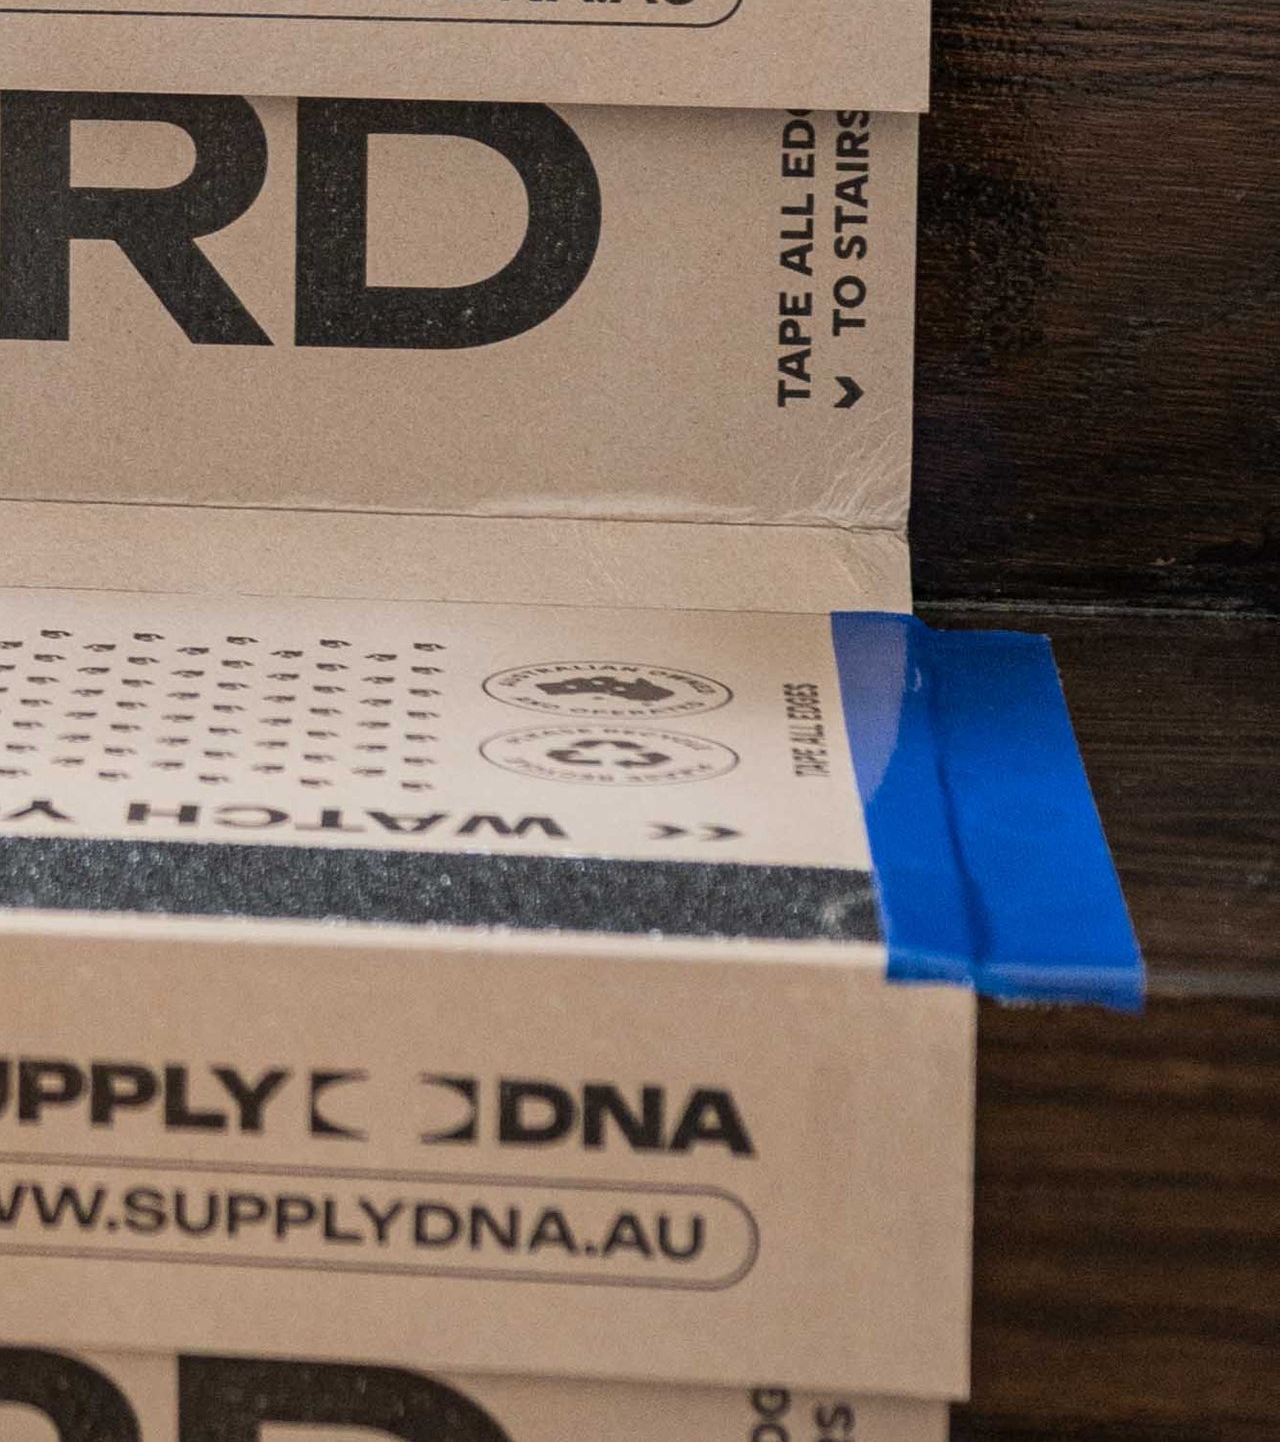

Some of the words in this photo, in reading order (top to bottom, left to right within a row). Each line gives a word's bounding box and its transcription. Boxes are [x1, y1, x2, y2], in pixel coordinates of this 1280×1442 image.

[832, 110, 870, 262] STAIRS
[780, 194, 814, 276] ALL
[832, 276, 866, 336] TO
[778, 292, 812, 407] TAPE
[124, 799, 570, 839] WATCH
[498, 1080, 755, 1157] DNA
